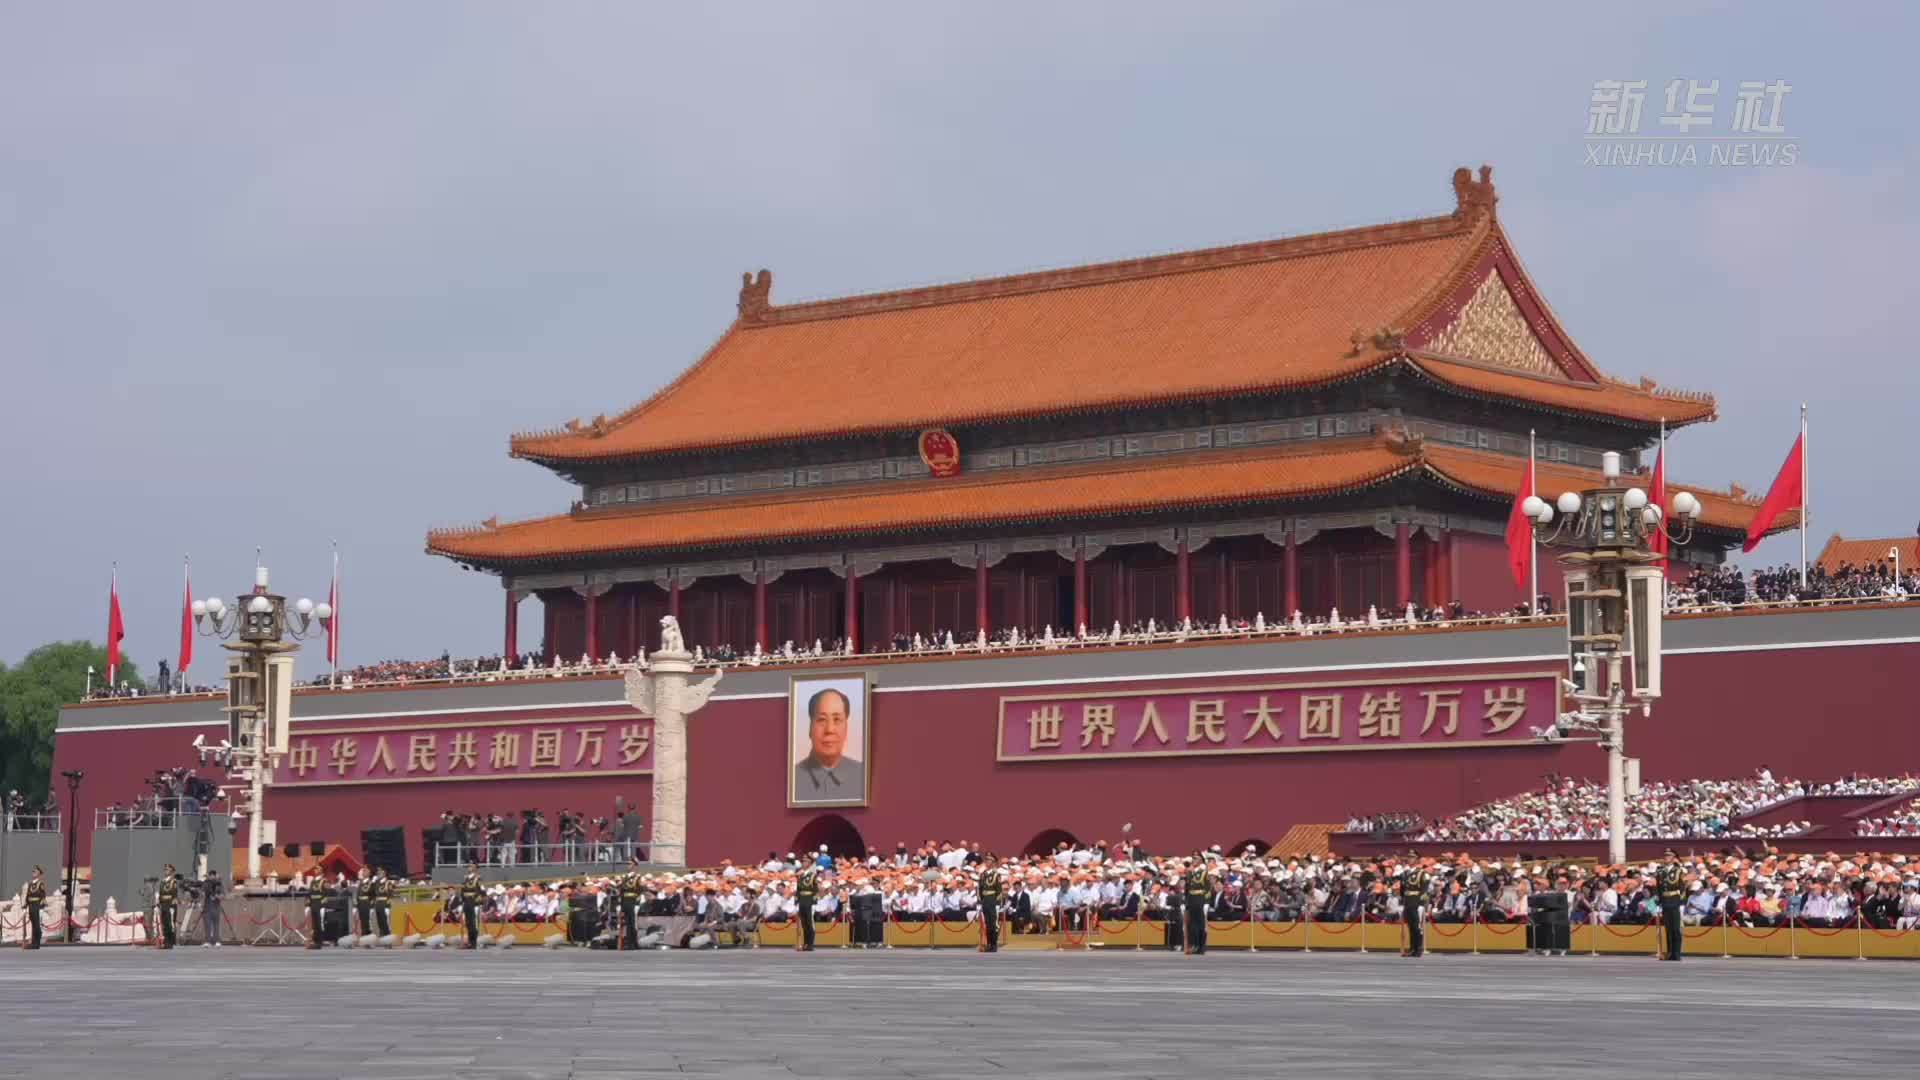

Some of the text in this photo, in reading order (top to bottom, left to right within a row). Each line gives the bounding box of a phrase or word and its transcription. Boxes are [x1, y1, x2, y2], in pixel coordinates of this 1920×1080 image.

[1027, 686, 1528, 749] 世界人民大团结万岁
[289, 725, 651, 777] 中华人民共和国万岁
